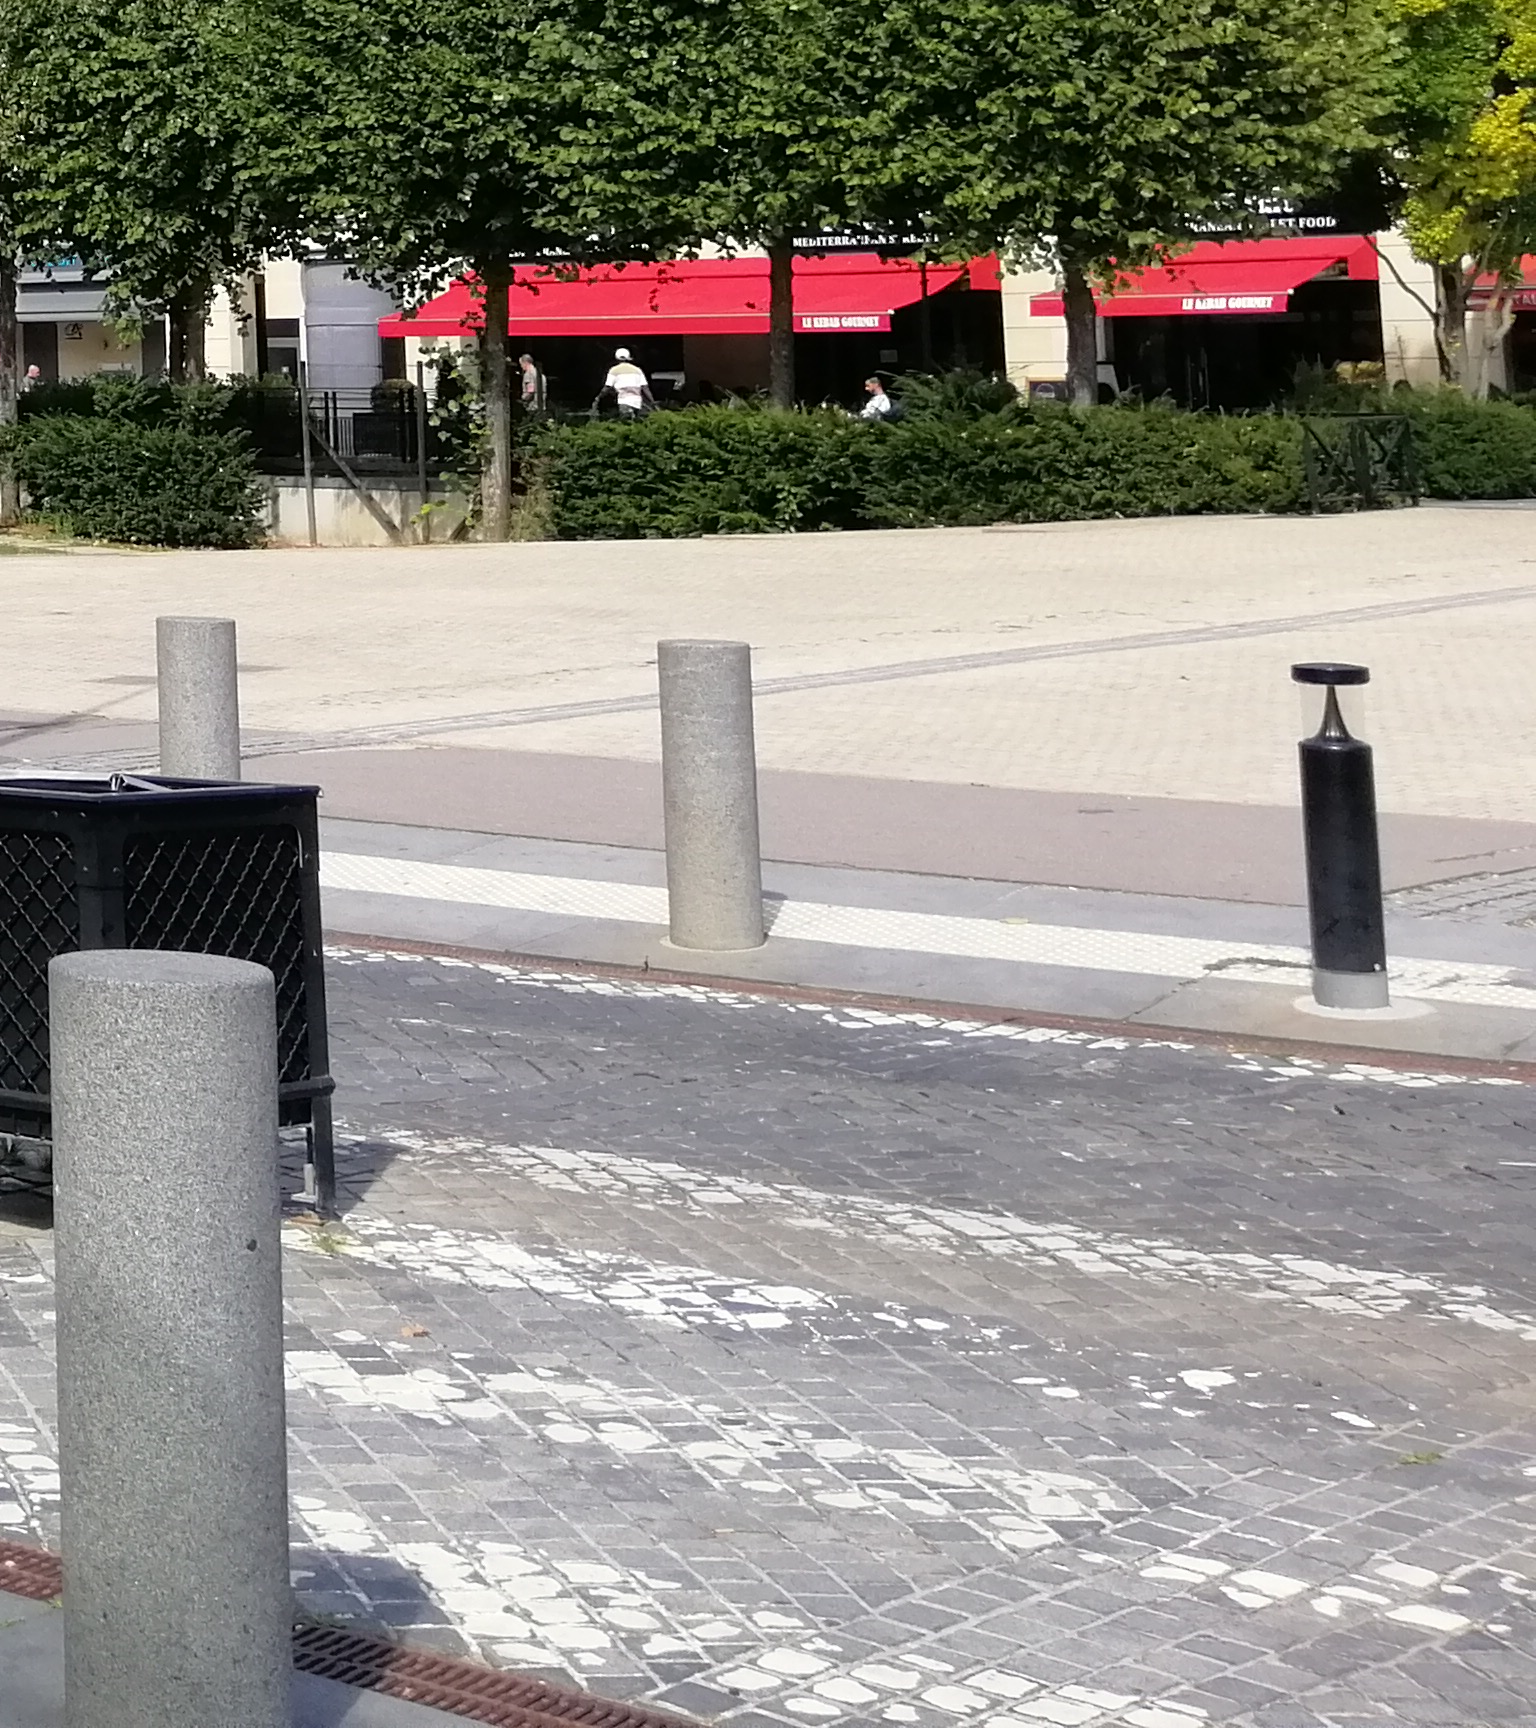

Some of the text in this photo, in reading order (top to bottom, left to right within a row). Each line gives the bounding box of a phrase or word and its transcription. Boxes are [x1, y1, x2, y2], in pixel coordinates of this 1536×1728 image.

[1299, 217, 1337, 229] FOOD
[1228, 296, 1273, 309] GOURMET
[802, 316, 879, 328] LE KEBAB GOURMET
